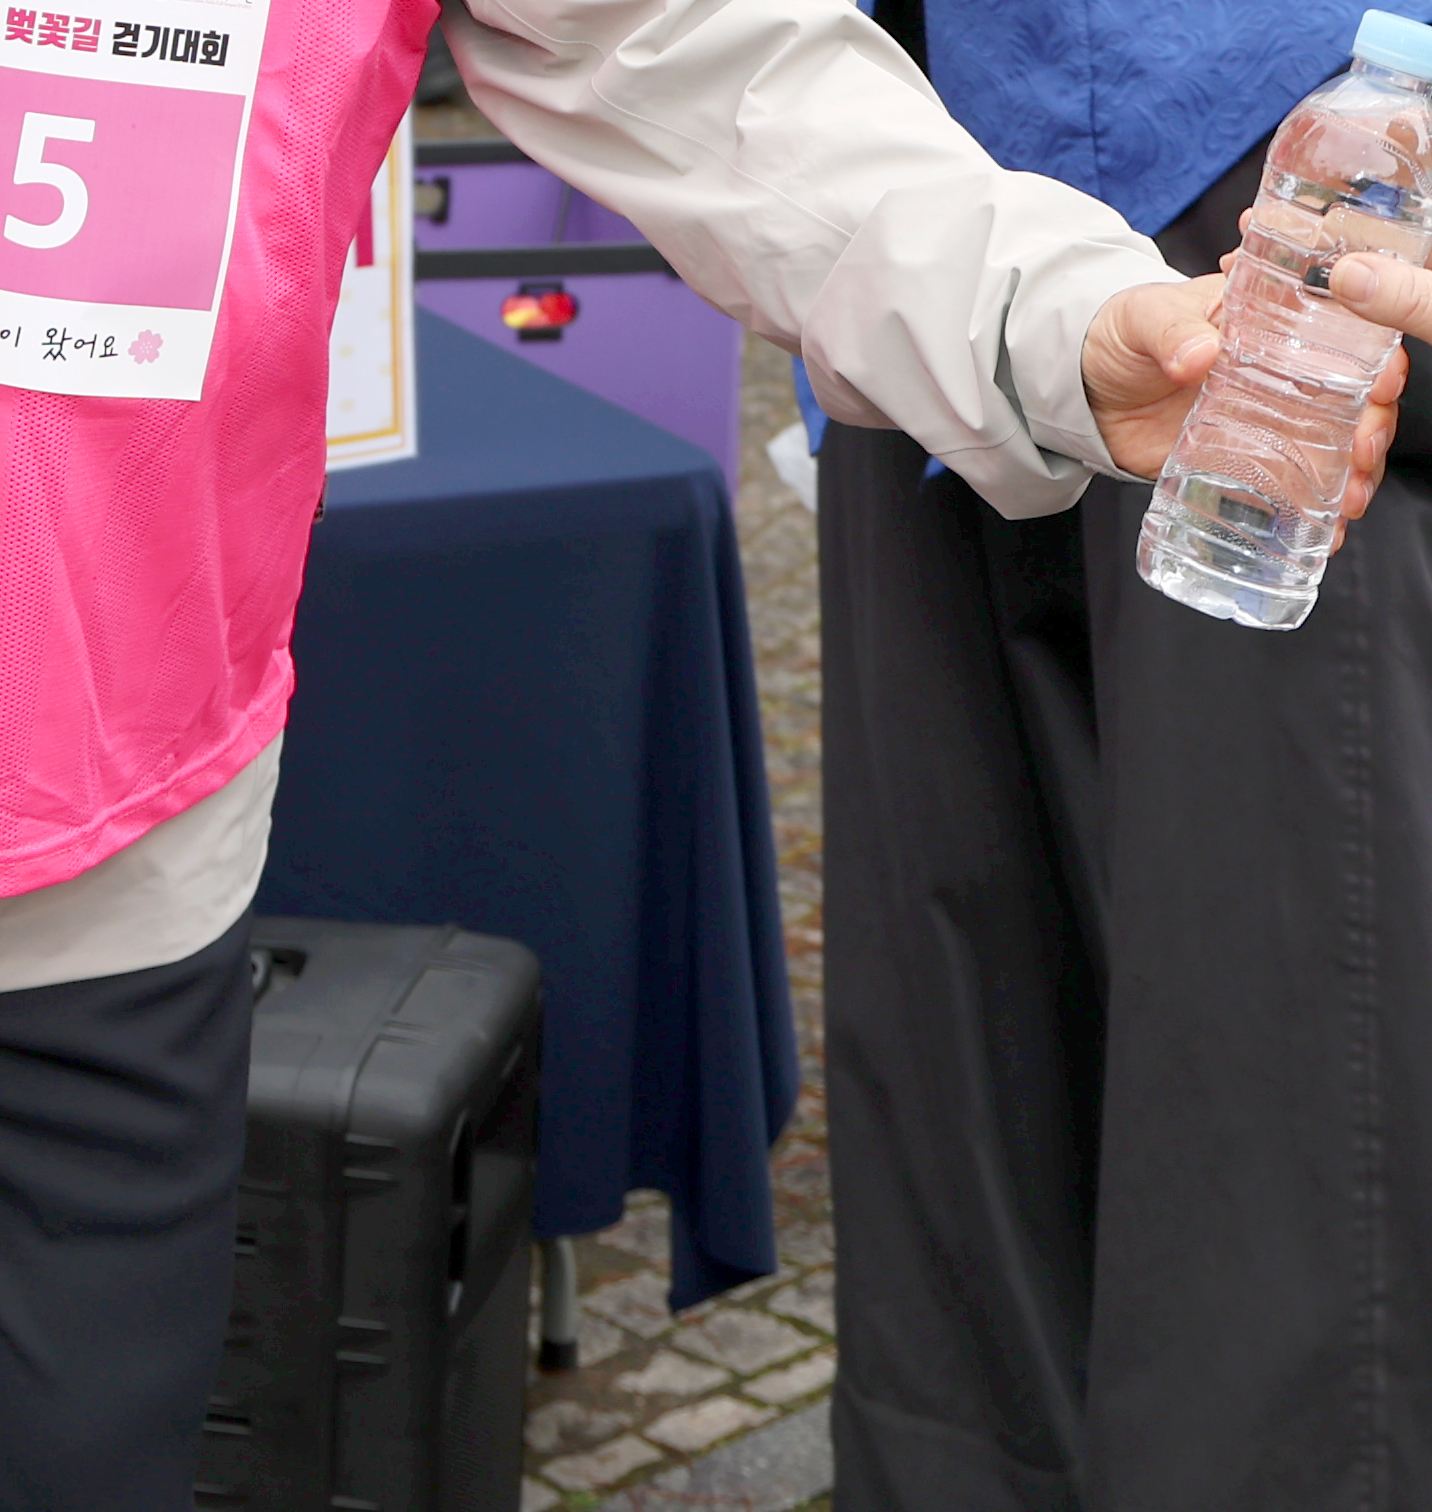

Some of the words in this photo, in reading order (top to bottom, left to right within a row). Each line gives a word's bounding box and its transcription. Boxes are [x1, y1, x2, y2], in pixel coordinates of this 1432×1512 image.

[5, 6, 103, 54] 벚꽃길
[112, 21, 230, 67] 걷기대회
[40, 325, 121, 362] 왔어요
